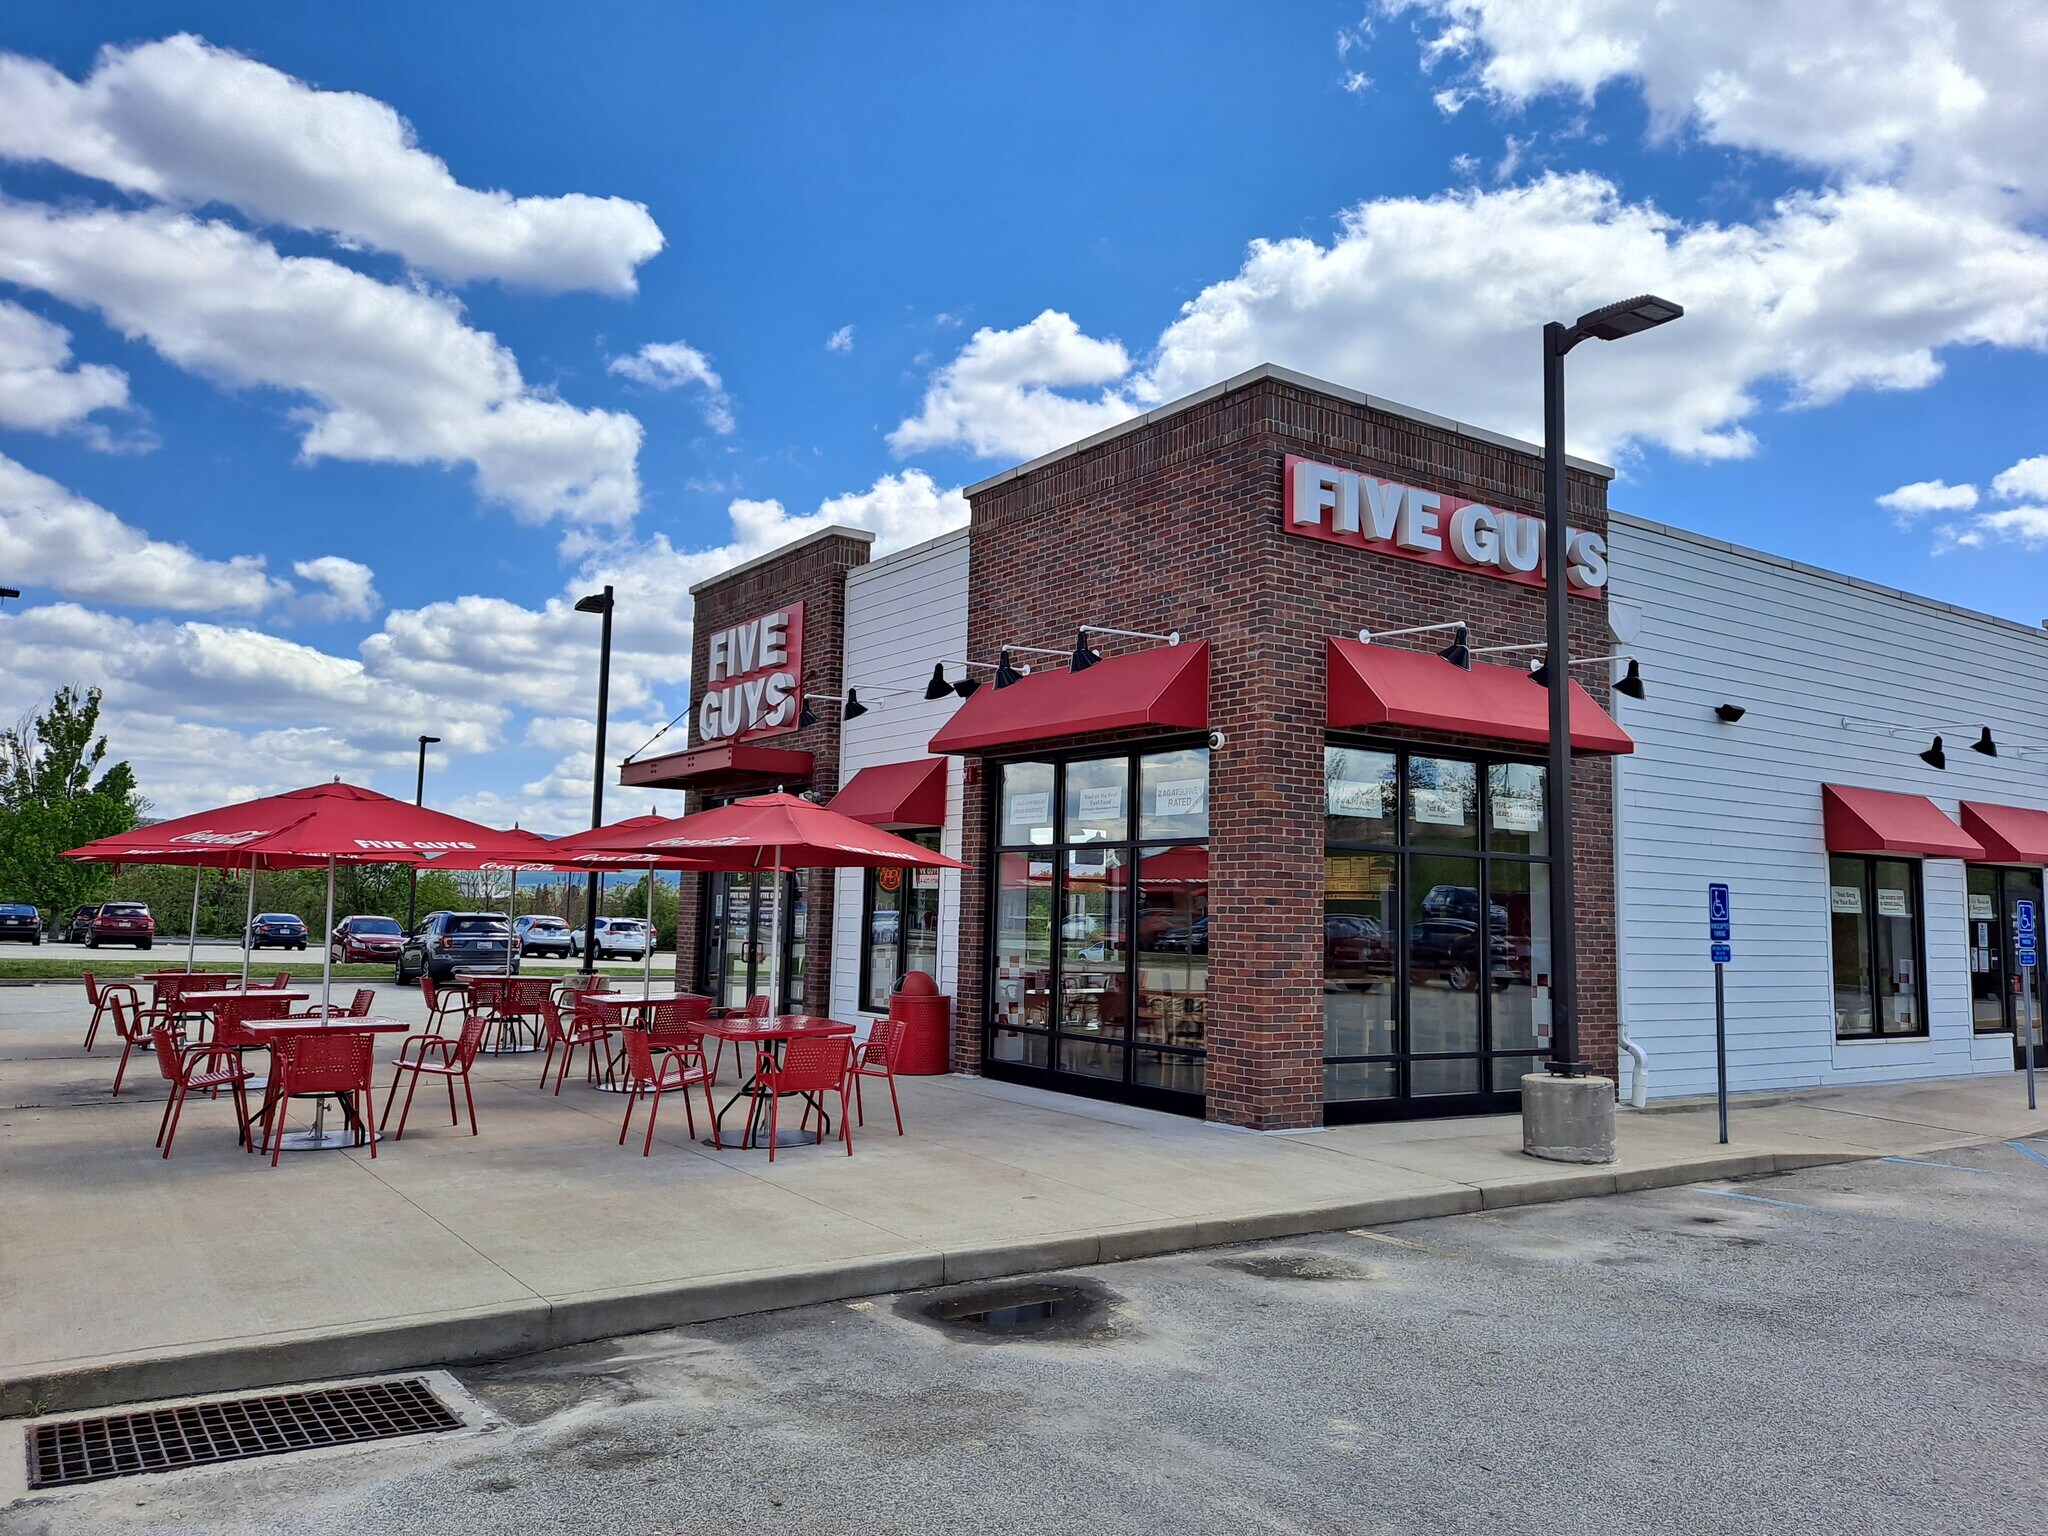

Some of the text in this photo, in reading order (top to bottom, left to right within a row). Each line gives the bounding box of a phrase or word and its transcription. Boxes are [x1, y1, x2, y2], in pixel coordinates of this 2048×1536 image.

[1293, 460, 1443, 552] FIVE
[708, 611, 789, 683] FIVE
[699, 671, 797, 742] GUYS
[1167, 797, 1192, 807] RATED
[354, 839, 477, 850] FIVE GUYS
